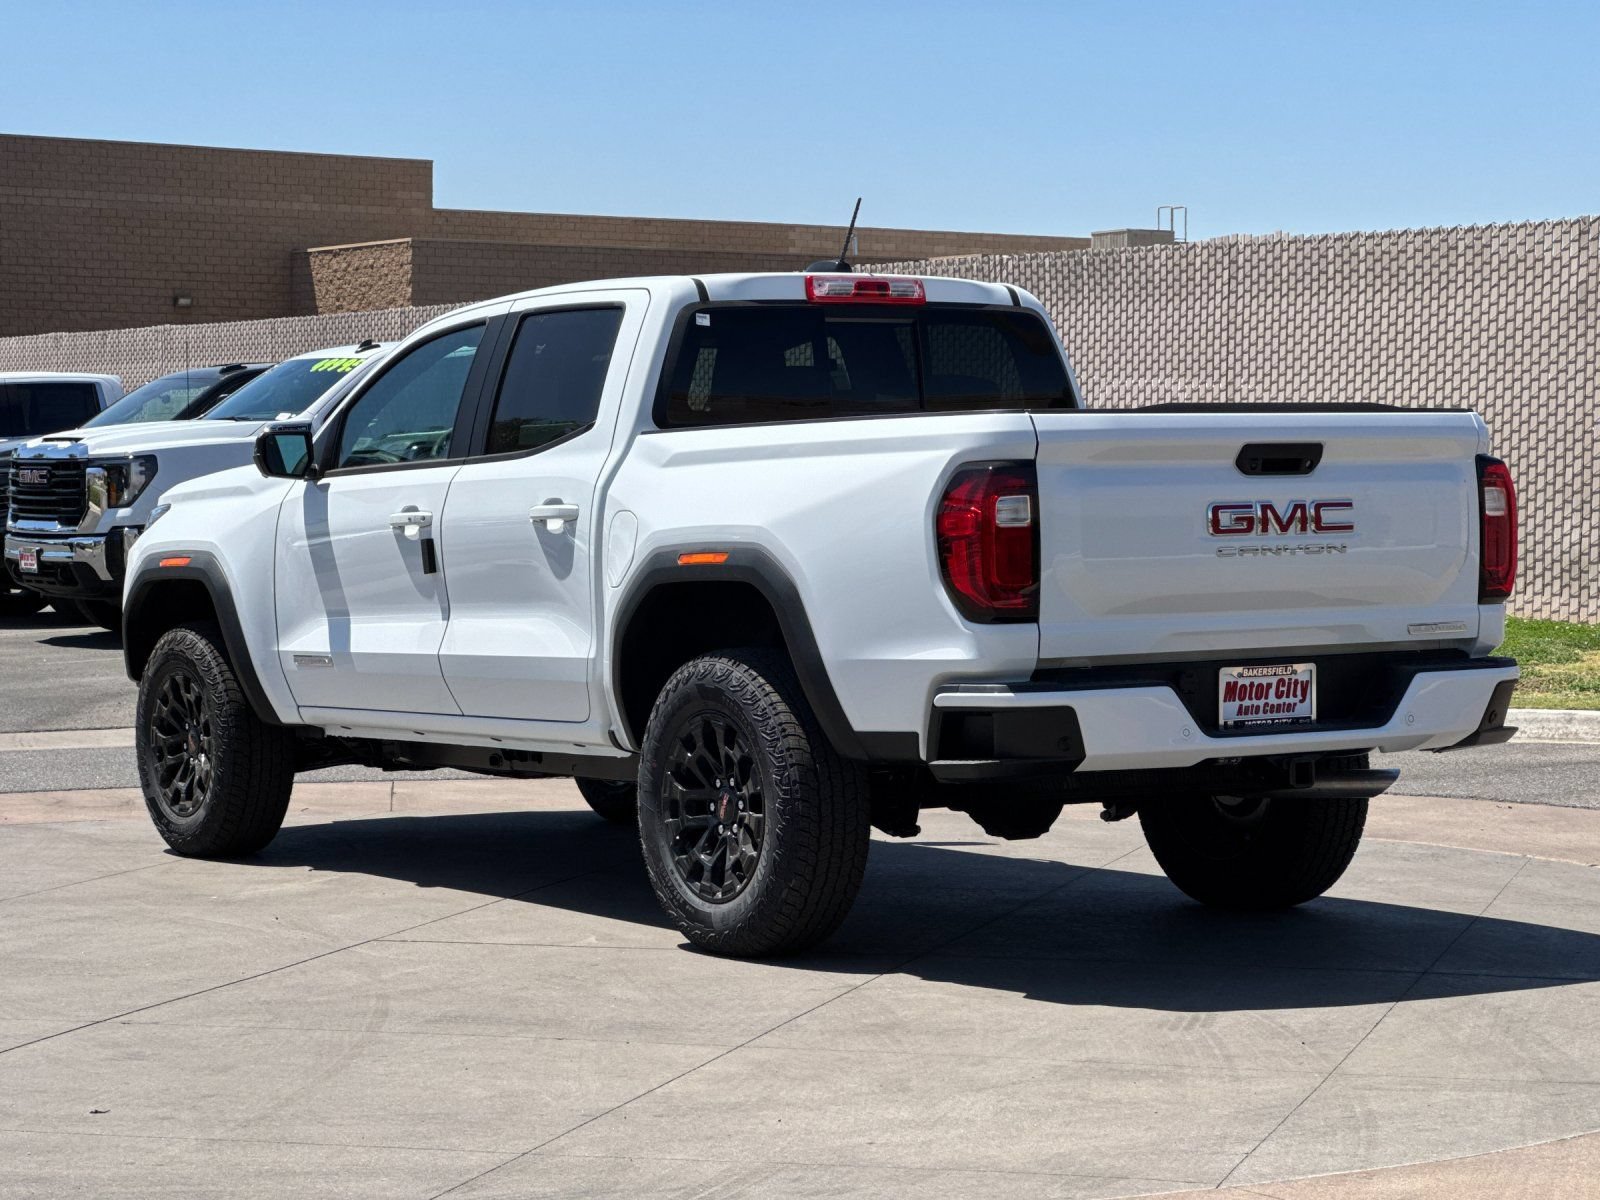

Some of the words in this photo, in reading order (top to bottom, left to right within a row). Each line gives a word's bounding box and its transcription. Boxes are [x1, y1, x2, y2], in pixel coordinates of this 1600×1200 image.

[19, 470, 47, 483] GMC
[1207, 499, 1354, 536] GMC
[1216, 543, 1347, 557] CANYON
[1243, 667, 1292, 677] BAKERSFIELD
[1223, 681, 1273, 703] Motor
[1275, 678, 1310, 703] City
[1236, 704, 1260, 716] Auto
[1262, 702, 1297, 715] Center
